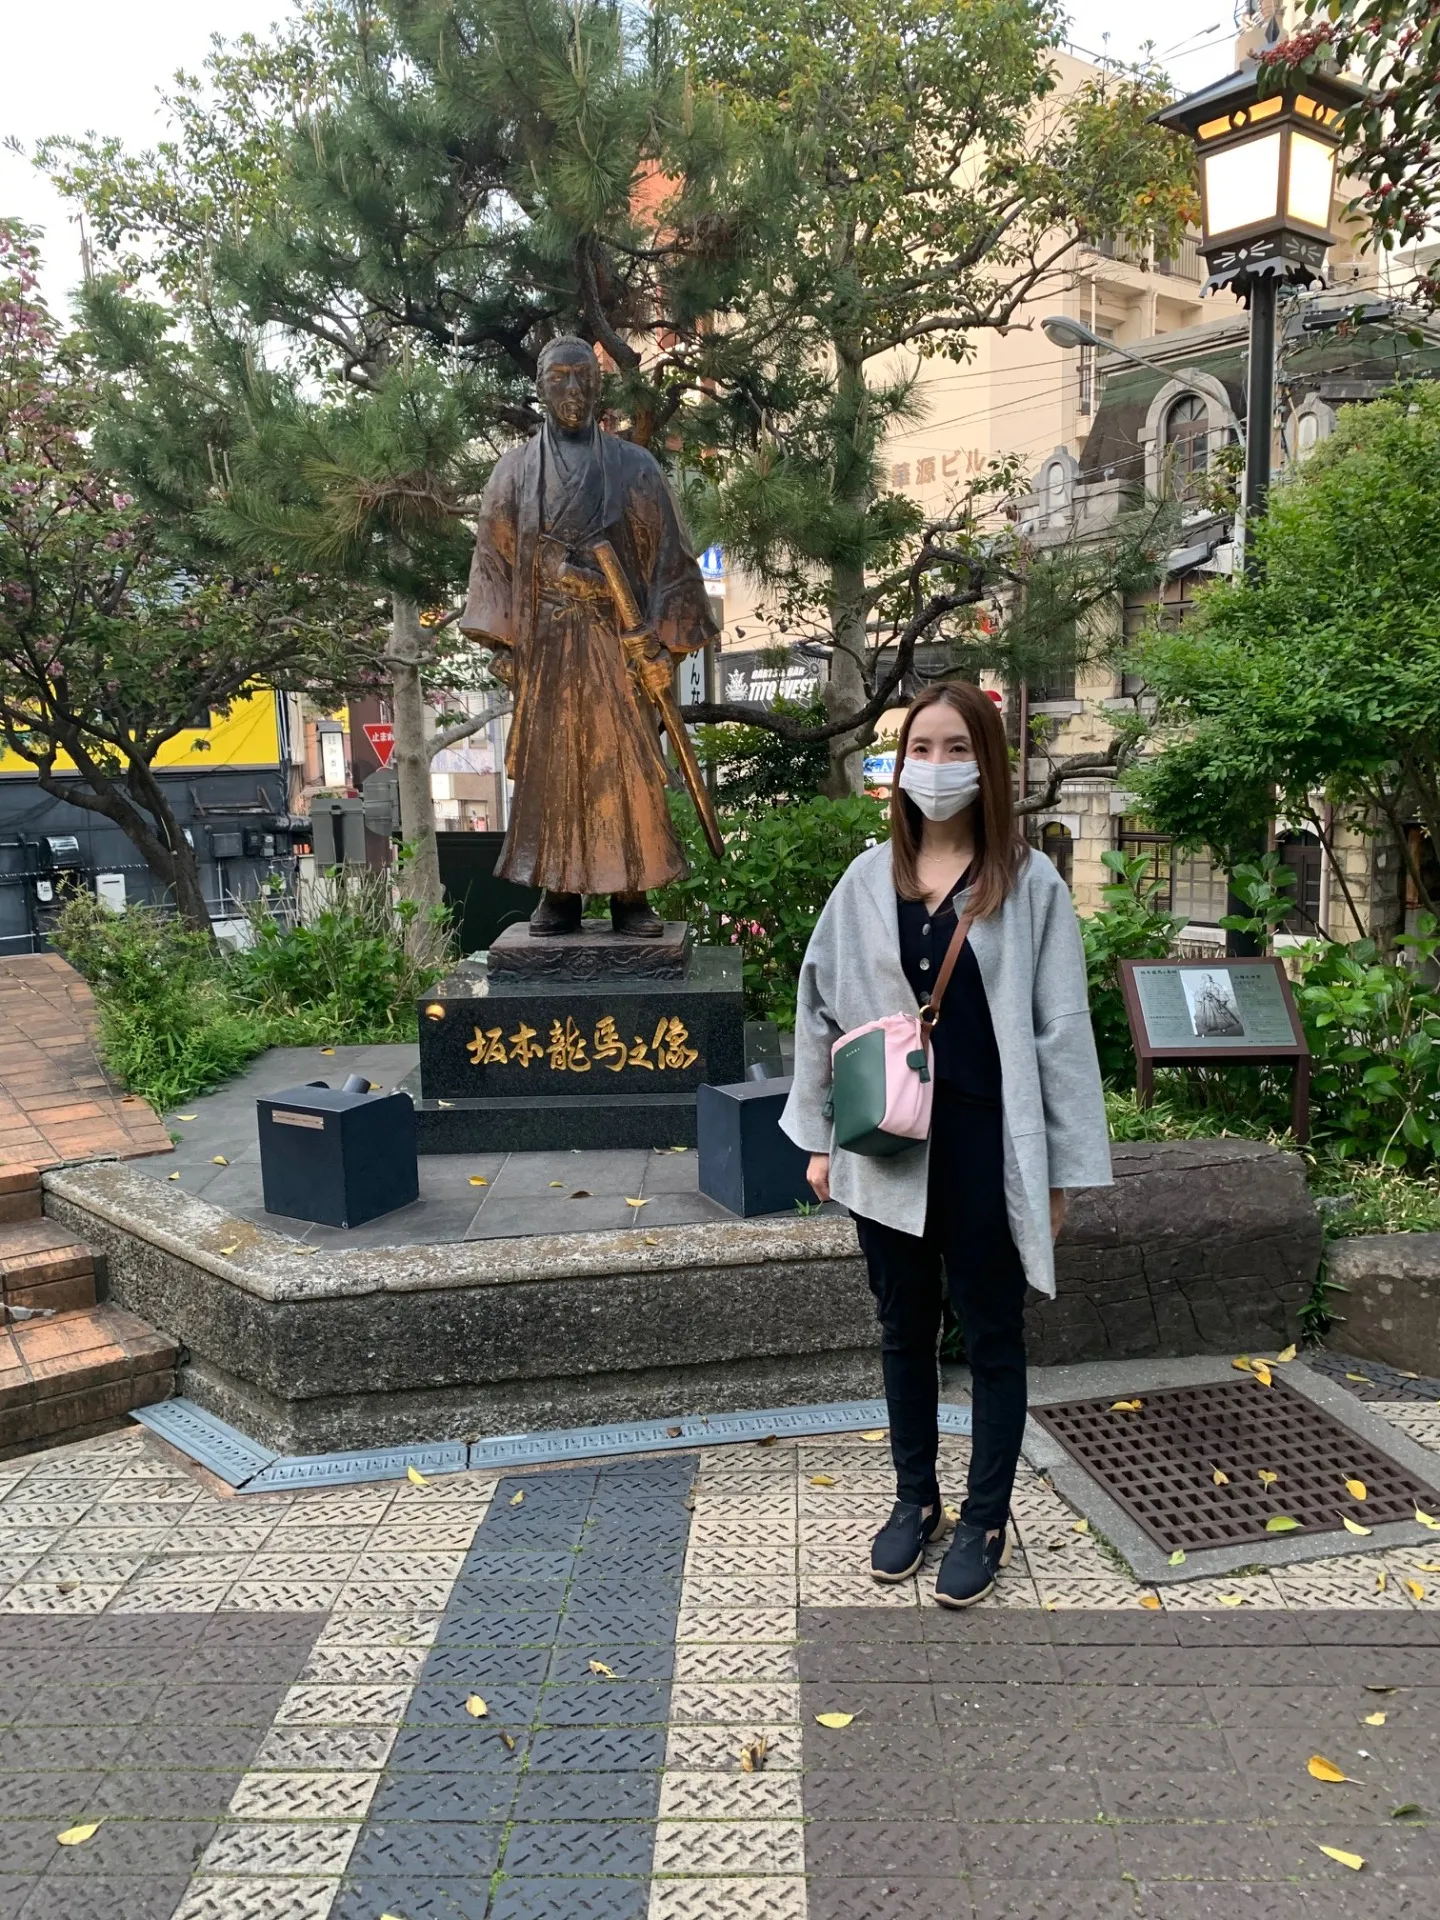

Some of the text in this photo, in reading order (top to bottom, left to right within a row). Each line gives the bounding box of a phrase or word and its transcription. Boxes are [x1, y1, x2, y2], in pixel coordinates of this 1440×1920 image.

[787, 666, 806, 677] BAR
[372, 732, 395, 742] 止まれ
[466, 1015, 698, 1073] 坂本龍馬之像
